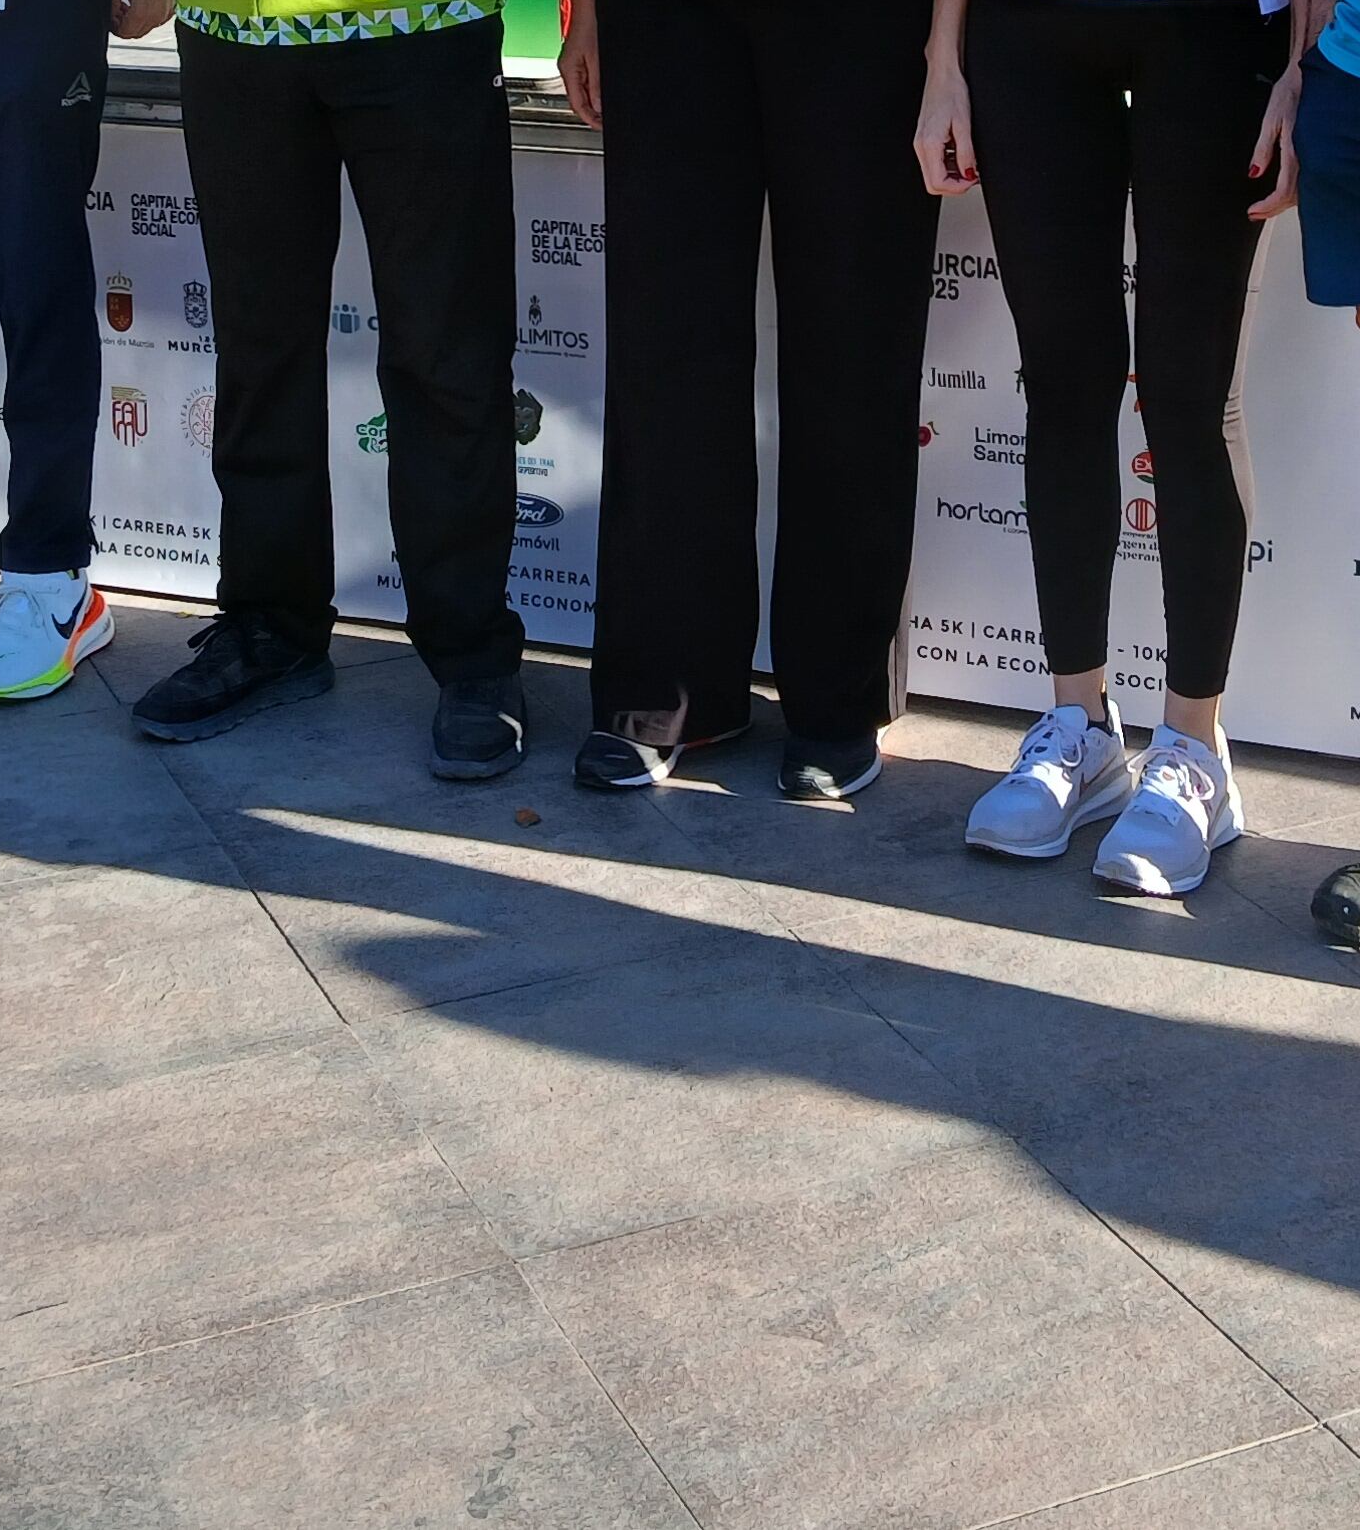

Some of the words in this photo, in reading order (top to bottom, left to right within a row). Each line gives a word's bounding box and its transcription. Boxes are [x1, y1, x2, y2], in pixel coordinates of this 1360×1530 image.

[131, 193, 181, 211] CAPITAL
[131, 207, 148, 222] DE
[151, 209, 167, 223] LA
[131, 222, 177, 238] SOCIAL
[531, 219, 588, 237] CAPITAL
[531, 234, 551, 249] DE
[554, 235, 572, 251] LA
[531, 249, 583, 267] SOCIAL
[927, 366, 988, 390] Jumilla
[112, 518, 187, 538] CARRERA
[192, 528, 212, 541] 5K
[124, 544, 211, 566] ECONOMÍA
[508, 565, 591, 587] CARRERA
[940, 619, 964, 635] 5K
[1132, 644, 1168, 663] 10K
[916, 645, 958, 663] CON
[966, 651, 989, 668] LA
